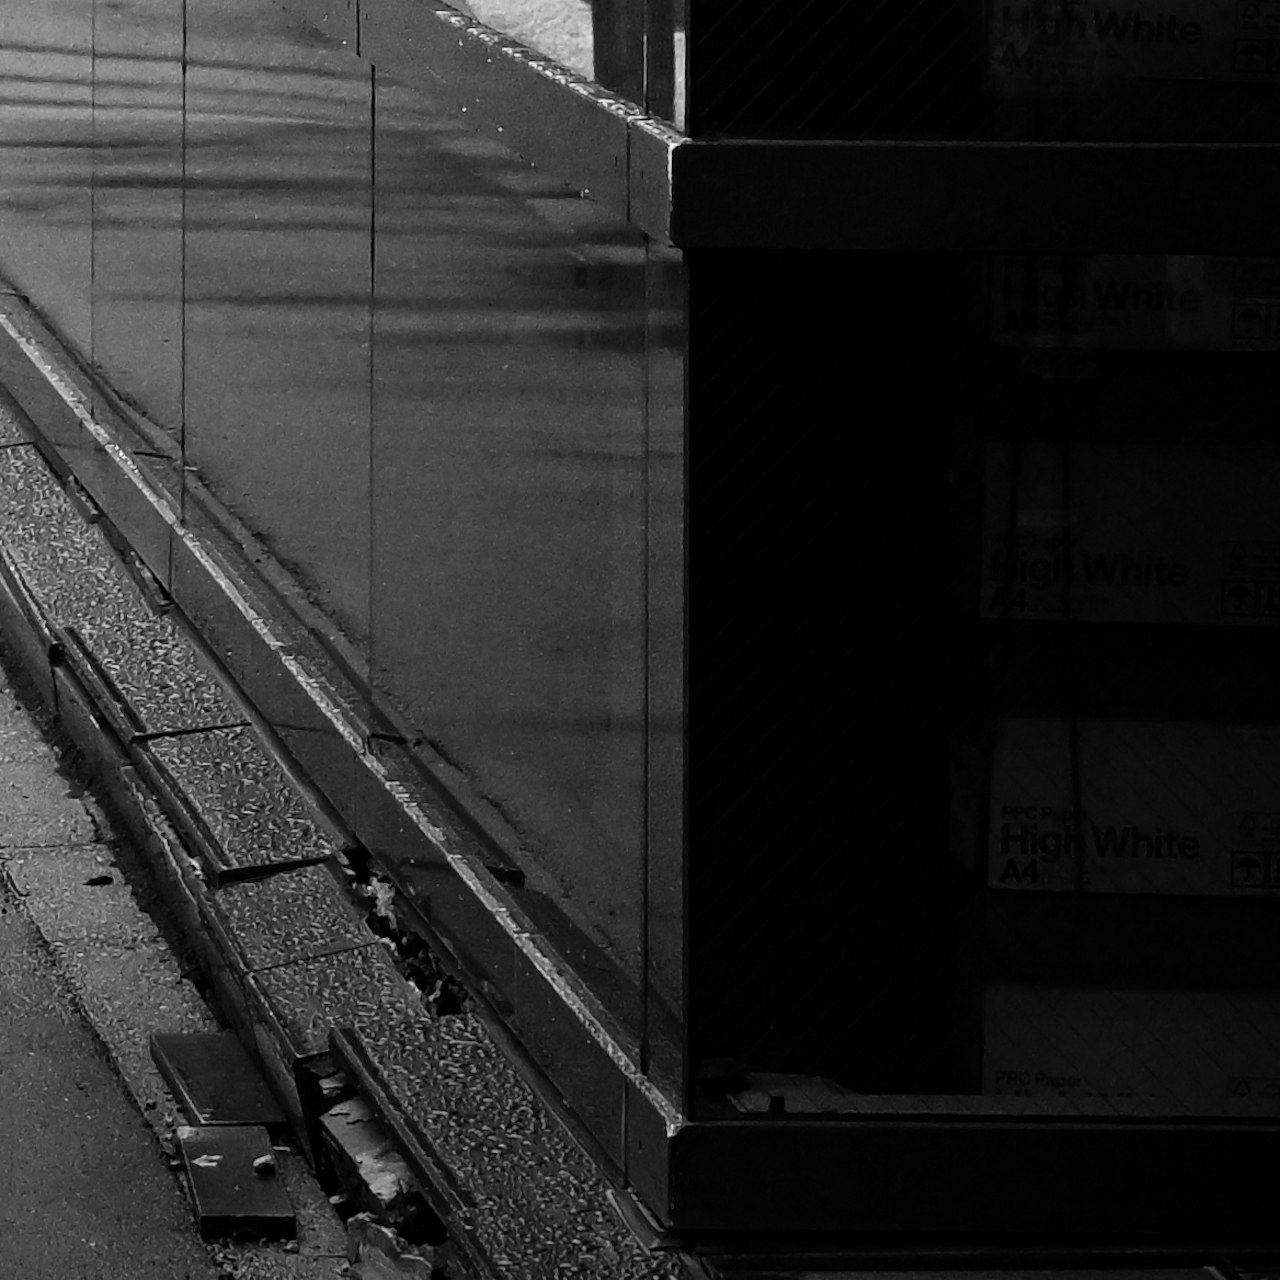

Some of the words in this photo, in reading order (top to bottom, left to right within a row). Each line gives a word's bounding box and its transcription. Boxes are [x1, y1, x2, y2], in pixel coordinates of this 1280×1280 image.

[1093, 8, 1202, 45] White
[1081, 552, 1190, 588] White
[999, 822, 1085, 864] High
[1091, 825, 1201, 860] White
[998, 858, 1040, 884] A4
